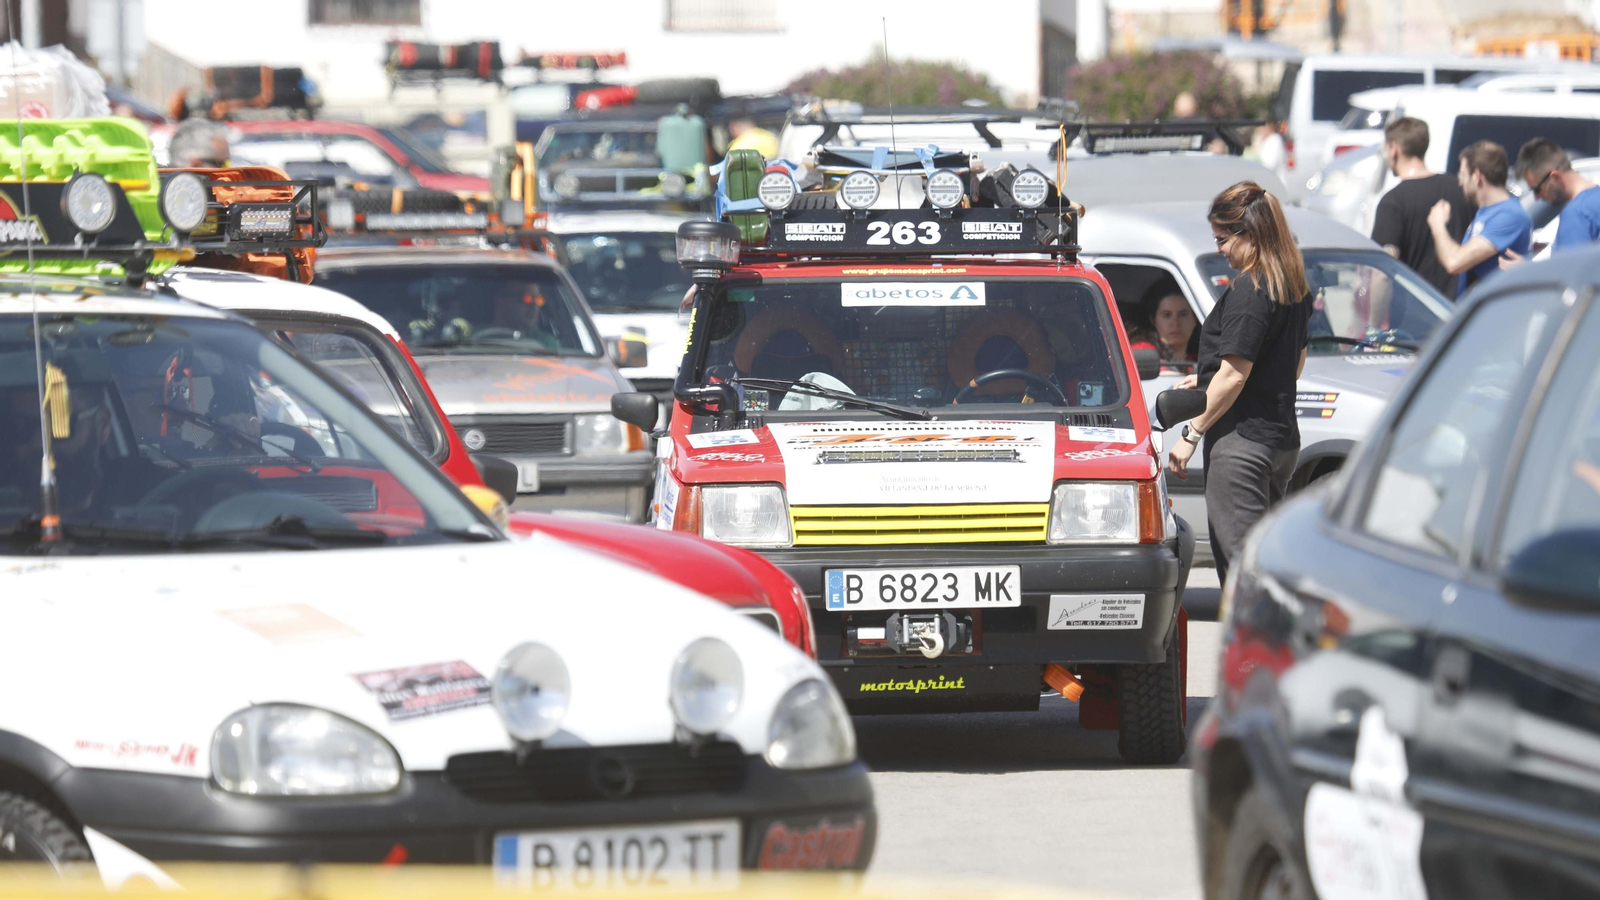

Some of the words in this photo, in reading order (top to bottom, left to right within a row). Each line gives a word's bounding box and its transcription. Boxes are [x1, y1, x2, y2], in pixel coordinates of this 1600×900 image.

[785, 223, 846, 234] SEAT
[866, 221, 942, 245] 263
[962, 222, 1022, 233] SEAT
[855, 287, 943, 299] abetos
[832, 593, 840, 602] E
[846, 574, 863, 604] B
[879, 573, 959, 603] 6823
[974, 572, 1012, 602] MK
[860, 675, 966, 694] motosprint
[532, 842, 556, 889] B
[573, 837, 669, 889] 8102
[684, 833, 726, 884] TT
